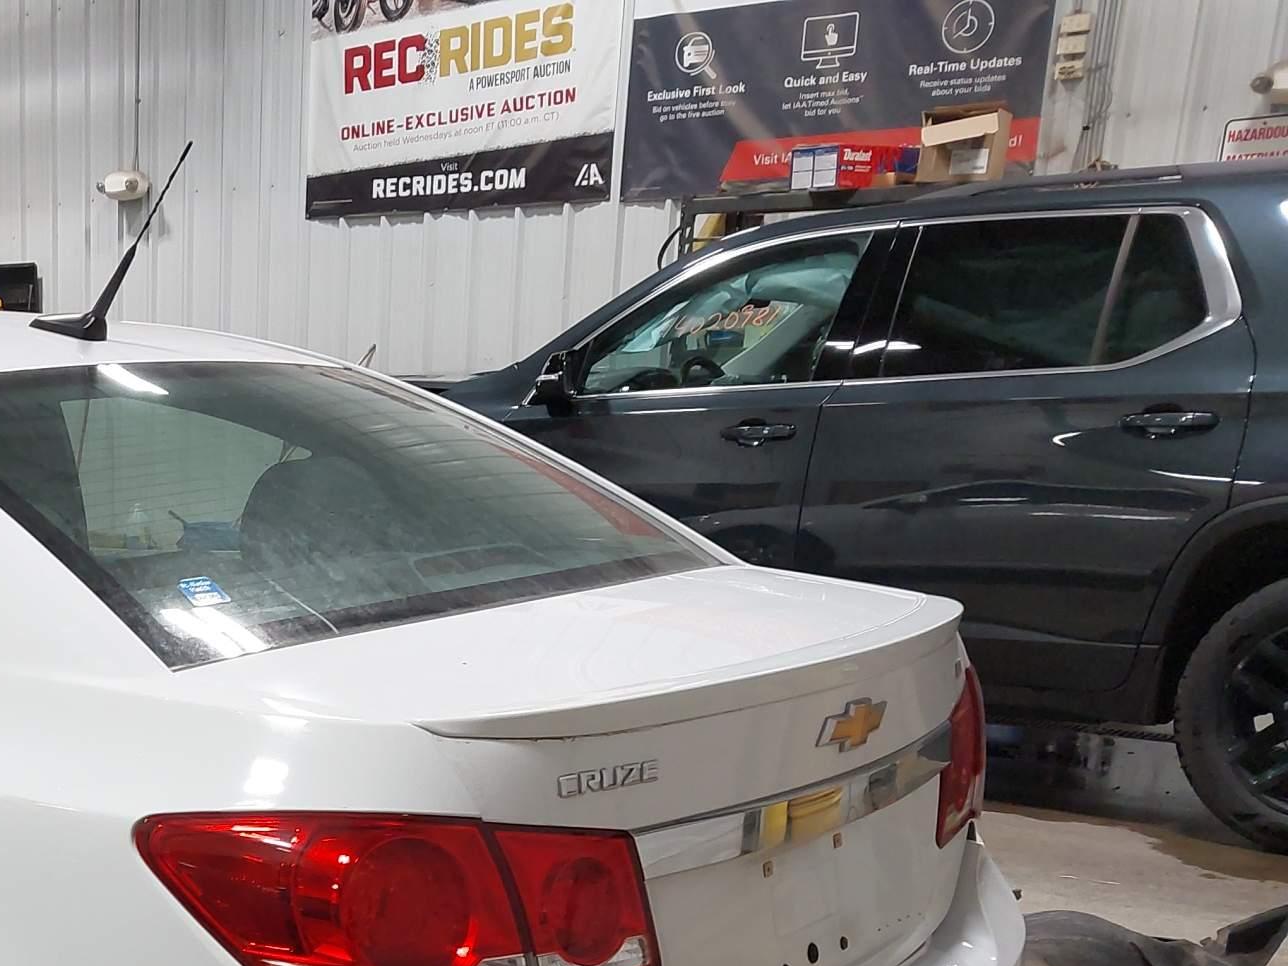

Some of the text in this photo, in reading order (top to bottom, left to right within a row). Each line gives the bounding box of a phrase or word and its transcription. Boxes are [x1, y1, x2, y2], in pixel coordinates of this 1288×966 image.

[344, 2, 574, 95] REC RIDES
[908, 56, 1023, 76] Real-Time Updates
[468, 60, 571, 91] A POWERSPORT AUCTION
[784, 71, 868, 88] Quick and Easy
[919, 74, 1006, 88] Receive status updates
[647, 82, 746, 102] Exclusive First Look
[799, 91, 819, 99] Insert
[931, 88, 953, 96] about
[954, 86, 973, 95] your
[699, 100, 719, 109] before
[817, 108, 827, 116] for
[828, 107, 841, 115] you
[341, 87, 577, 141] ONLINE-EXCLUSIVE AUCTION
[353, 141, 382, 152] Auction
[383, 137, 401, 148] held
[402, 130, 453, 146] Wednesdays
[454, 129, 462, 137] at
[463, 126, 483, 136] noon
[485, 121, 495, 132] ET
[543, 112, 560, 122] CT)
[440, 161, 458, 172] Visit
[753, 152, 778, 166] Visit
[372, 168, 527, 200] RECRIDES.COM
[557, 759, 659, 799] CRUZE
